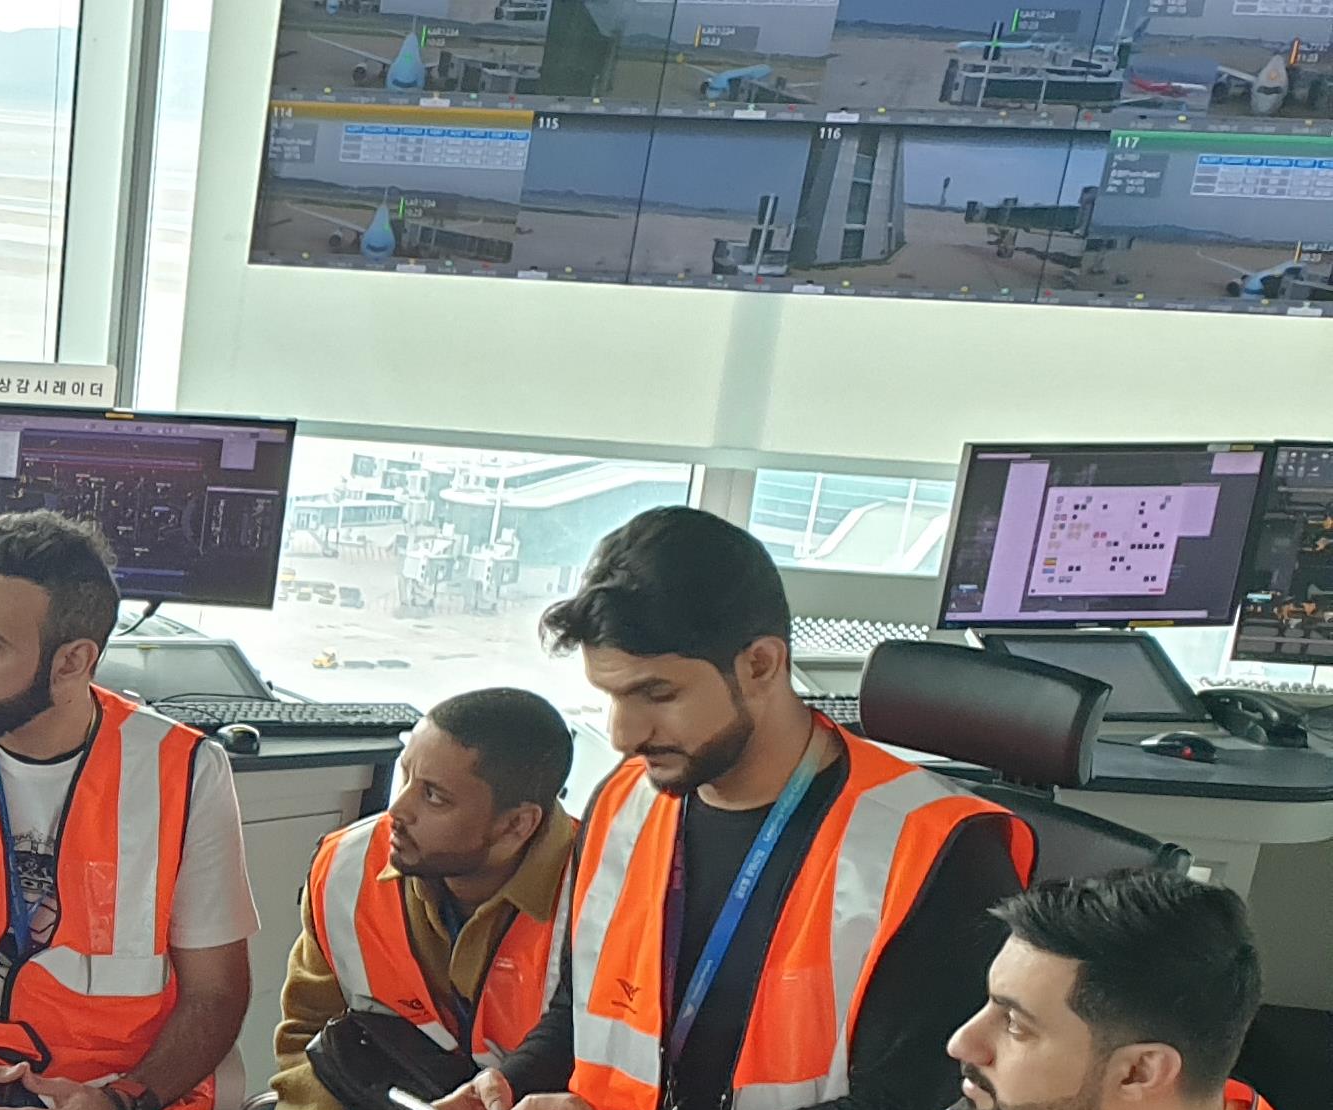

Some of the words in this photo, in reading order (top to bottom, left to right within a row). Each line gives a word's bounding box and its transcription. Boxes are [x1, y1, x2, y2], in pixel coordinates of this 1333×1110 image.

[273, 106, 293, 119] 114
[538, 117, 560, 130] 115
[819, 127, 841, 139] 116
[1117, 136, 1140, 149] 117
